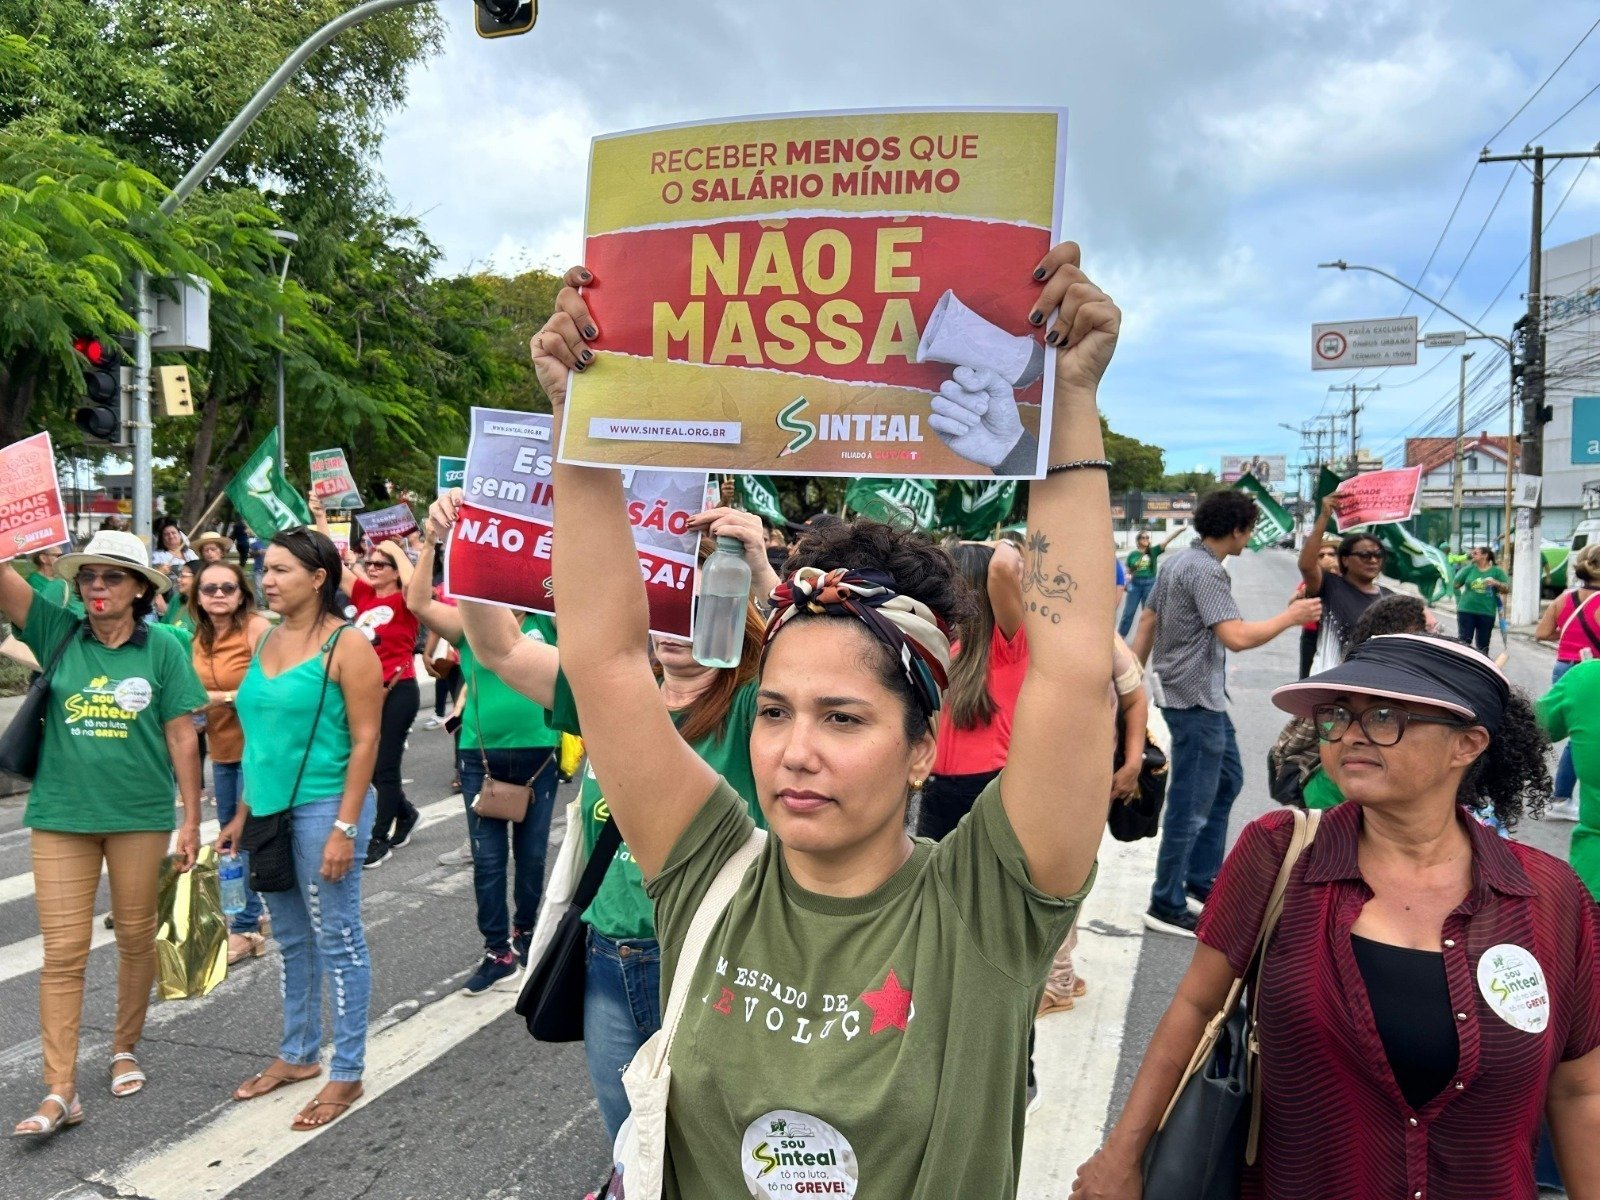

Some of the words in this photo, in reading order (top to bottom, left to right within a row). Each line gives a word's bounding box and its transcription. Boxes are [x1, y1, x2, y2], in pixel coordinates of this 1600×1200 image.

[650, 142, 777, 174] RECEBER
[786, 136, 901, 165] MENOS
[909, 134, 979, 160] QUE
[661, 180, 684, 205] O
[691, 170, 824, 203] SALÁRIO
[832, 164, 960, 197] MÍNIMO
[690, 218, 852, 296] NÃO
[874, 216, 923, 293] É
[652, 298, 924, 365] MASSA
[609, 424, 726, 437] WWW.SINTEAL.ORG.BR
[776, 396, 924, 458] SINTEAL
[841, 451, 867, 460] FILIADO
[471, 476, 526, 502] sem
[458, 517, 525, 552] NÃO
[92, 695, 114, 704] sou
[734, 966, 807, 1009] ESTADO
[823, 994, 849, 1012] DE
[1490, 972, 1540, 1006] Sinteal
[1505, 969, 1520, 980] sou
[752, 1141, 837, 1179] Sinteal
[780, 1139, 806, 1149] sou
[768, 1182, 778, 1191] tô
[780, 1183, 793, 1191] na
[794, 1181, 846, 1194] GREVE!
[780, 1170, 792, 1179] tô
[808, 1170, 829, 1180] luta,
